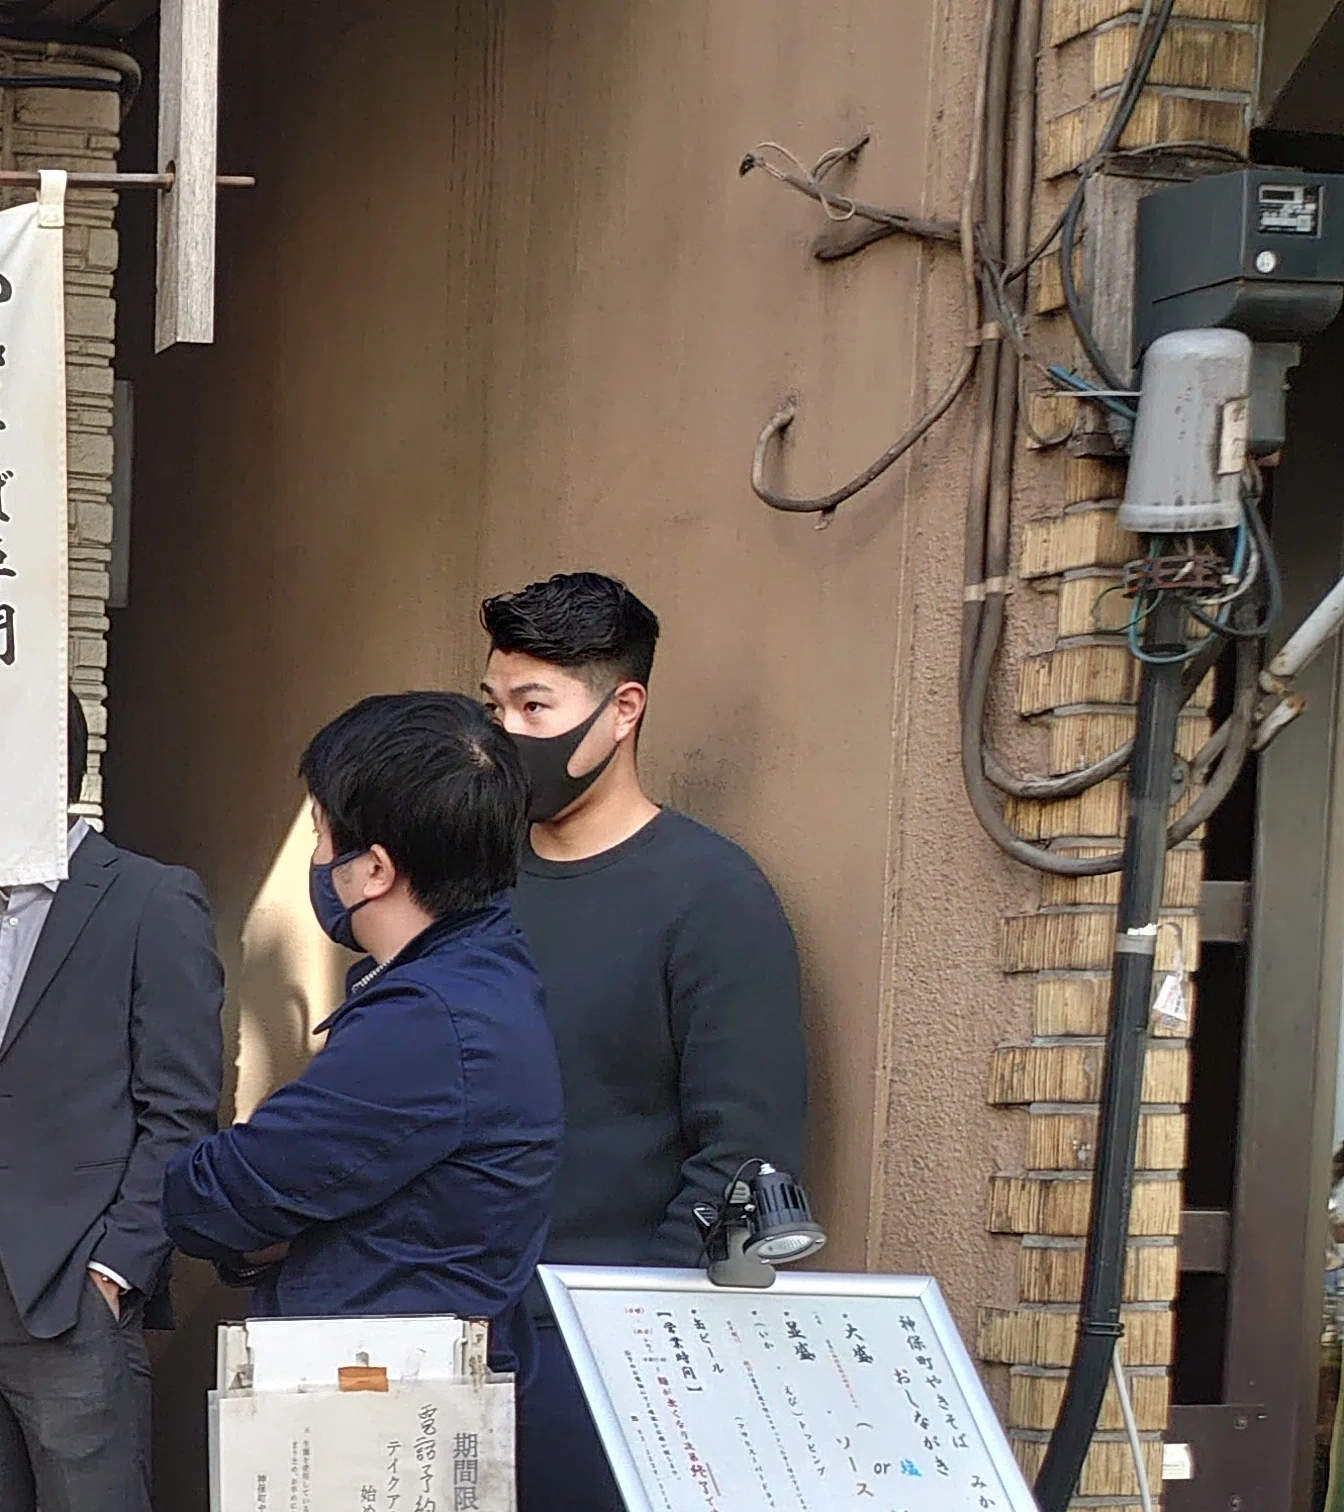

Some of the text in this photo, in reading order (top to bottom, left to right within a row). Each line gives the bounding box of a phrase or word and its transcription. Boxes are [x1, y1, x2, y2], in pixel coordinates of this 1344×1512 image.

[693, 1317, 724, 1374] 缶ビール
[785, 1320, 816, 1361] 並盛
[845, 1322, 874, 1364] 大盛
[897, 1315, 970, 1449] 神保町やきそば
[894, 1368, 949, 1476] おしながき
[873, 1462, 891, 1475] or
